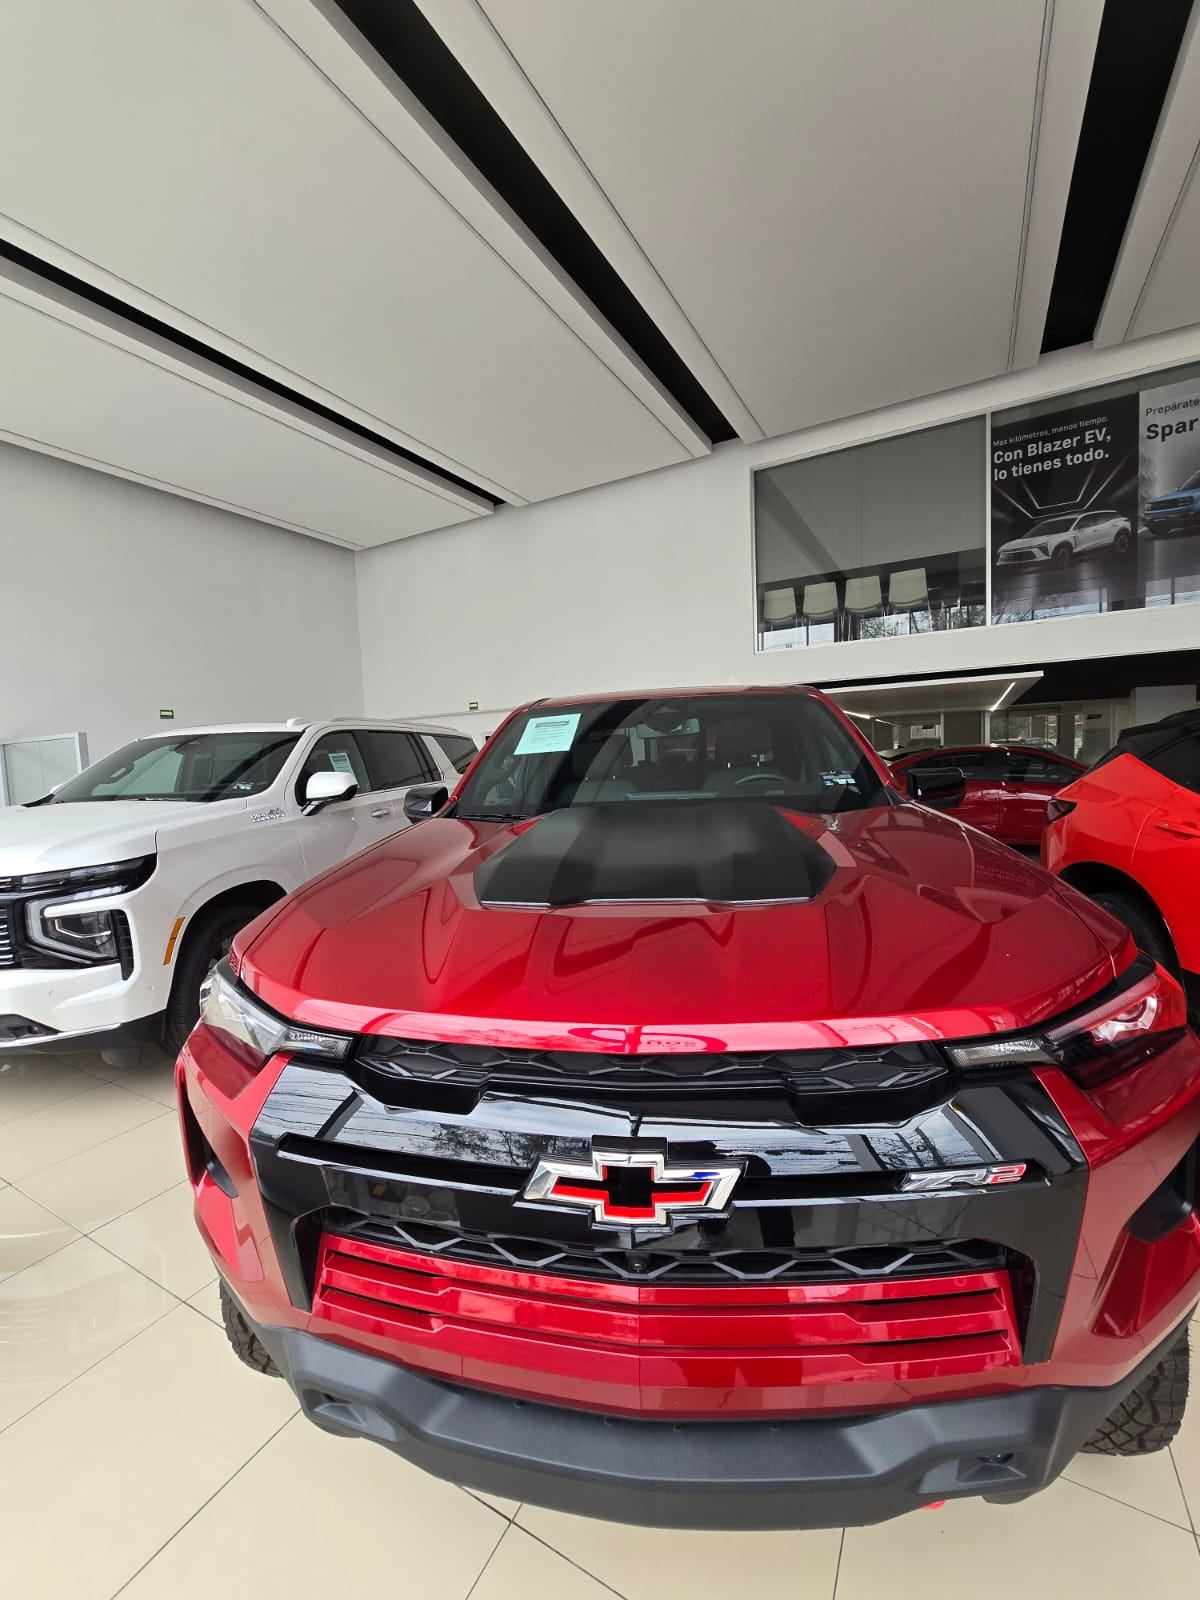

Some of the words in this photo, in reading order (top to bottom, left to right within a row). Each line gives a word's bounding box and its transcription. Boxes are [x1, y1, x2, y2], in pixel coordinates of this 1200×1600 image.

[1052, 424, 1078, 434] menos
[1146, 417, 1199, 442] Spar
[993, 449, 1023, 464] Con
[1027, 436, 1081, 457] Blazer
[1085, 427, 1112, 444] EV,
[994, 468, 1008, 481] lo
[1011, 458, 1062, 477] tienes
[1065, 448, 1109, 466] todo.
[901, 1164, 1027, 1192] ZR2
